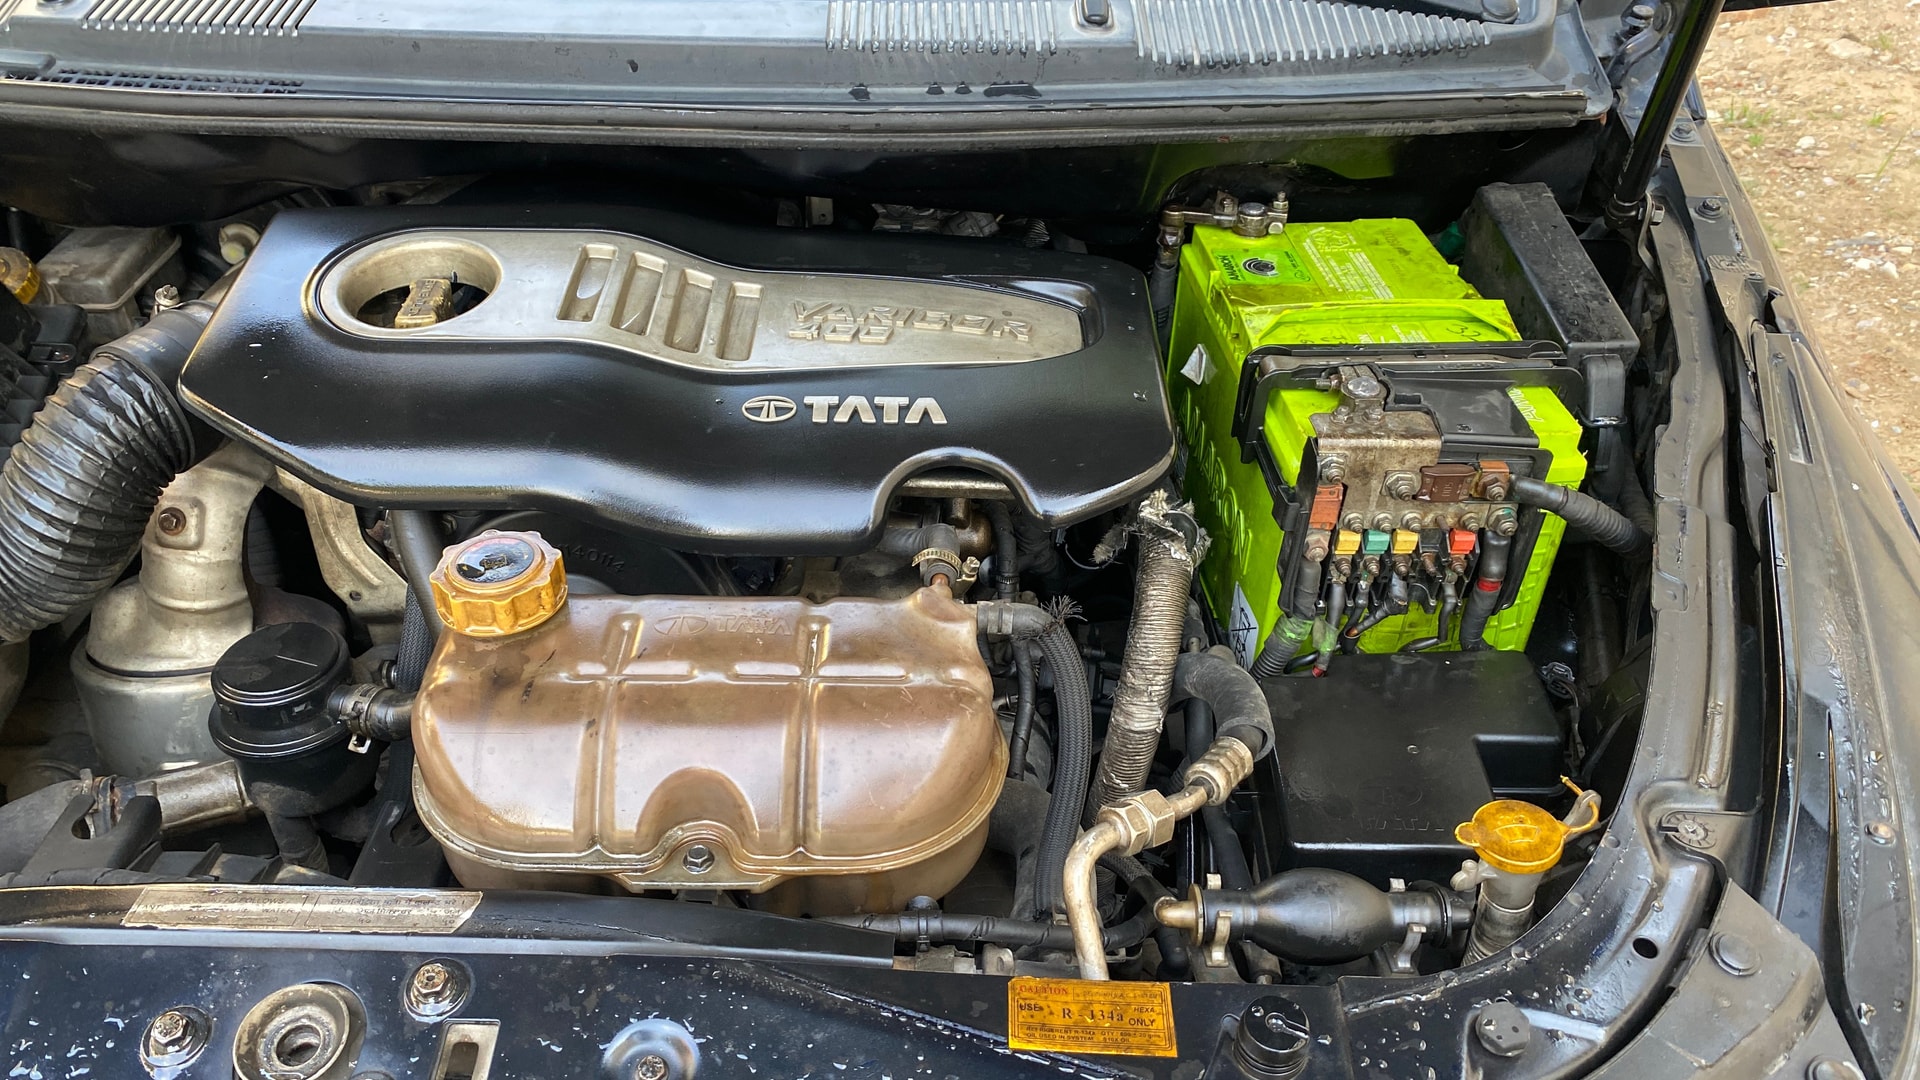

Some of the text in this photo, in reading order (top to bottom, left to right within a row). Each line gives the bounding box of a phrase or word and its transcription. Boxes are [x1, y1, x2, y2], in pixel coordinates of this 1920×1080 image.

[793, 300, 1033, 341] VARICOR
[804, 396, 948, 424] TATA
[714, 615, 793, 636] TATA
[1062, 1007, 1073, 1019] R
[1128, 1017, 1156, 1027] ONLY
